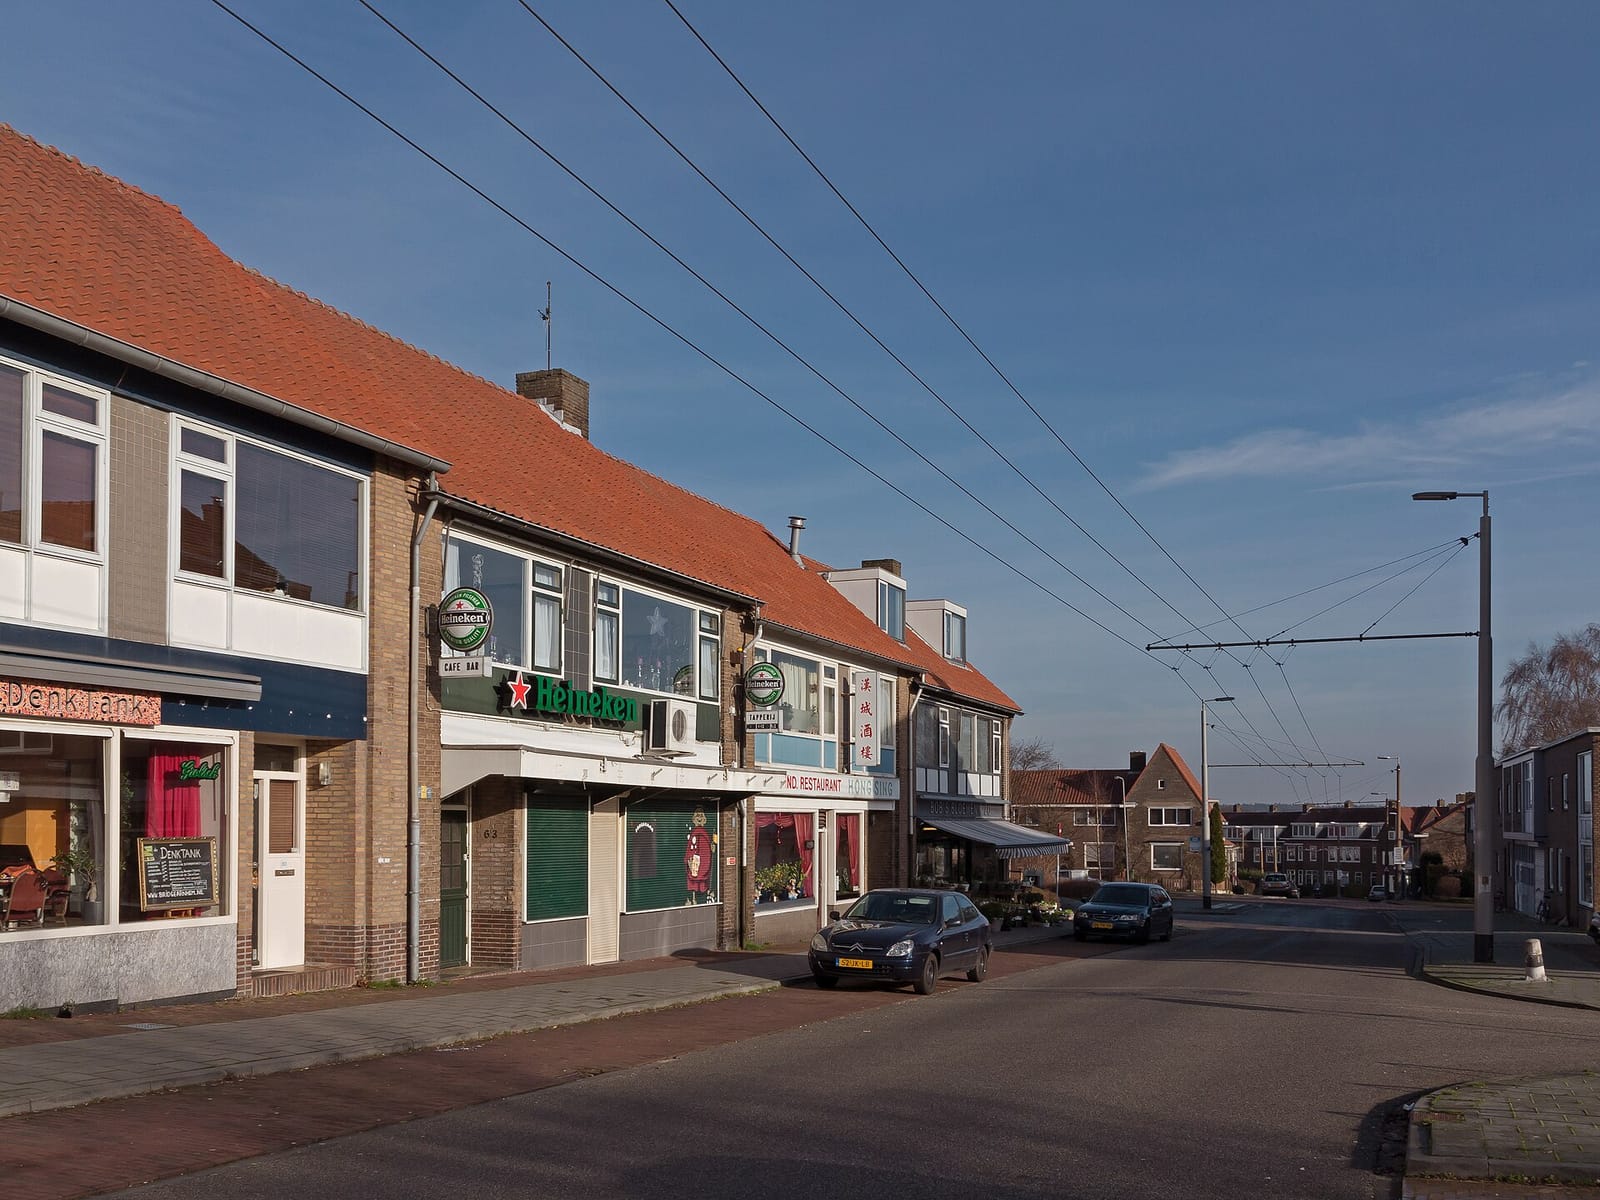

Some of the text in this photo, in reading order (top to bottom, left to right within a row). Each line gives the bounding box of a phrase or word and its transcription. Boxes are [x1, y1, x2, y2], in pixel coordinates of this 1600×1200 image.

[441, 612, 485, 624] Heineken
[444, 661, 479, 672] CAFE BAR
[535, 675, 637, 722] Heineken
[749, 713, 776, 721] TAPPERIJ
[860, 677, 873, 760] 漢城酒樓
[800, 777, 842, 792] RESTAURANT
[848, 779, 872, 794] HONG
[874, 782, 893, 796] SING
[483, 829, 498, 839] 63
